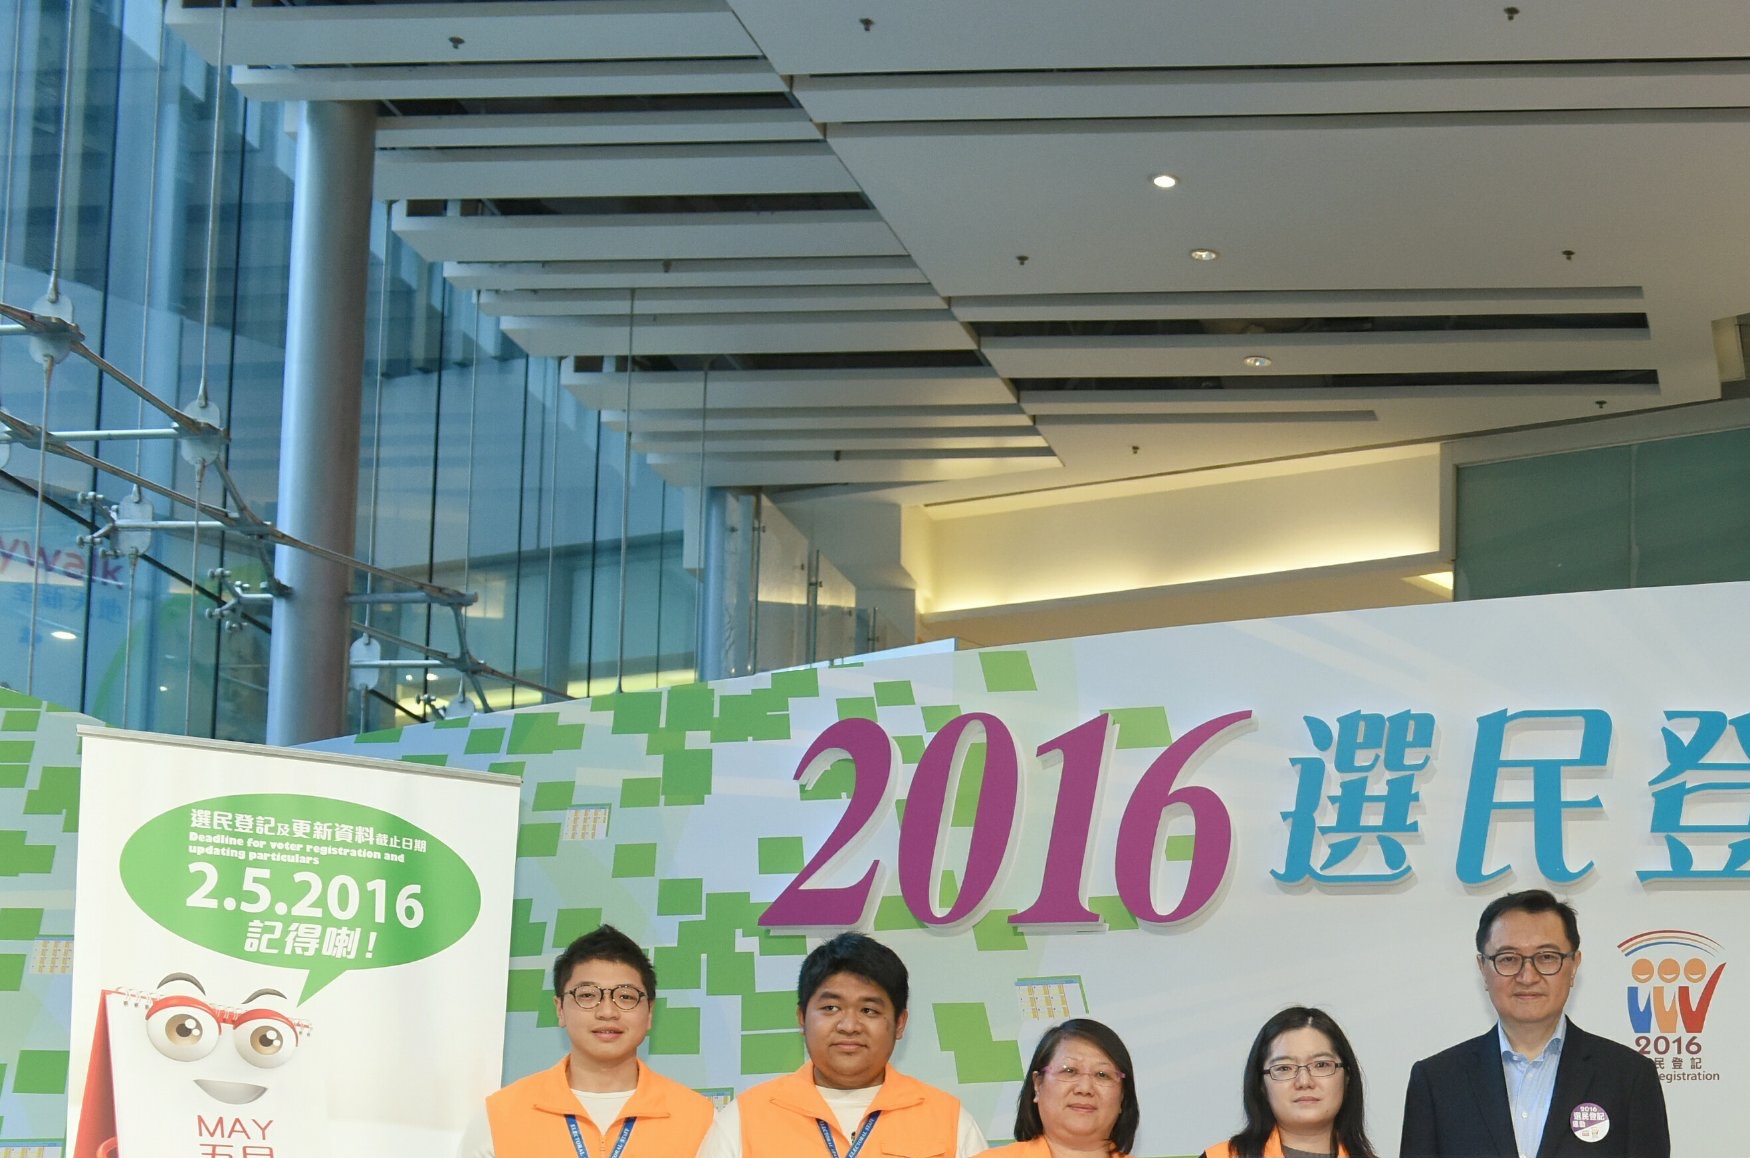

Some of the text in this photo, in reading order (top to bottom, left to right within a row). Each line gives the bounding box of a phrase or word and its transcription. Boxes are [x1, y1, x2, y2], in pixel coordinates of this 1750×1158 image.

[190, 808, 427, 854] 選民登記及更新資料截止日期
[757, 709, 1254, 928] 2016
[188, 844, 320, 864] updating particulars
[189, 832, 404, 862] Deadline for voter registration and
[186, 862, 424, 928] 2.5.2016
[1635, 1036, 1702, 1055] 2016
[1654, 1057, 1702, 1070] 民登記
[1659, 1071, 1720, 1083] egistration
[197, 1115, 274, 1140] MAY
